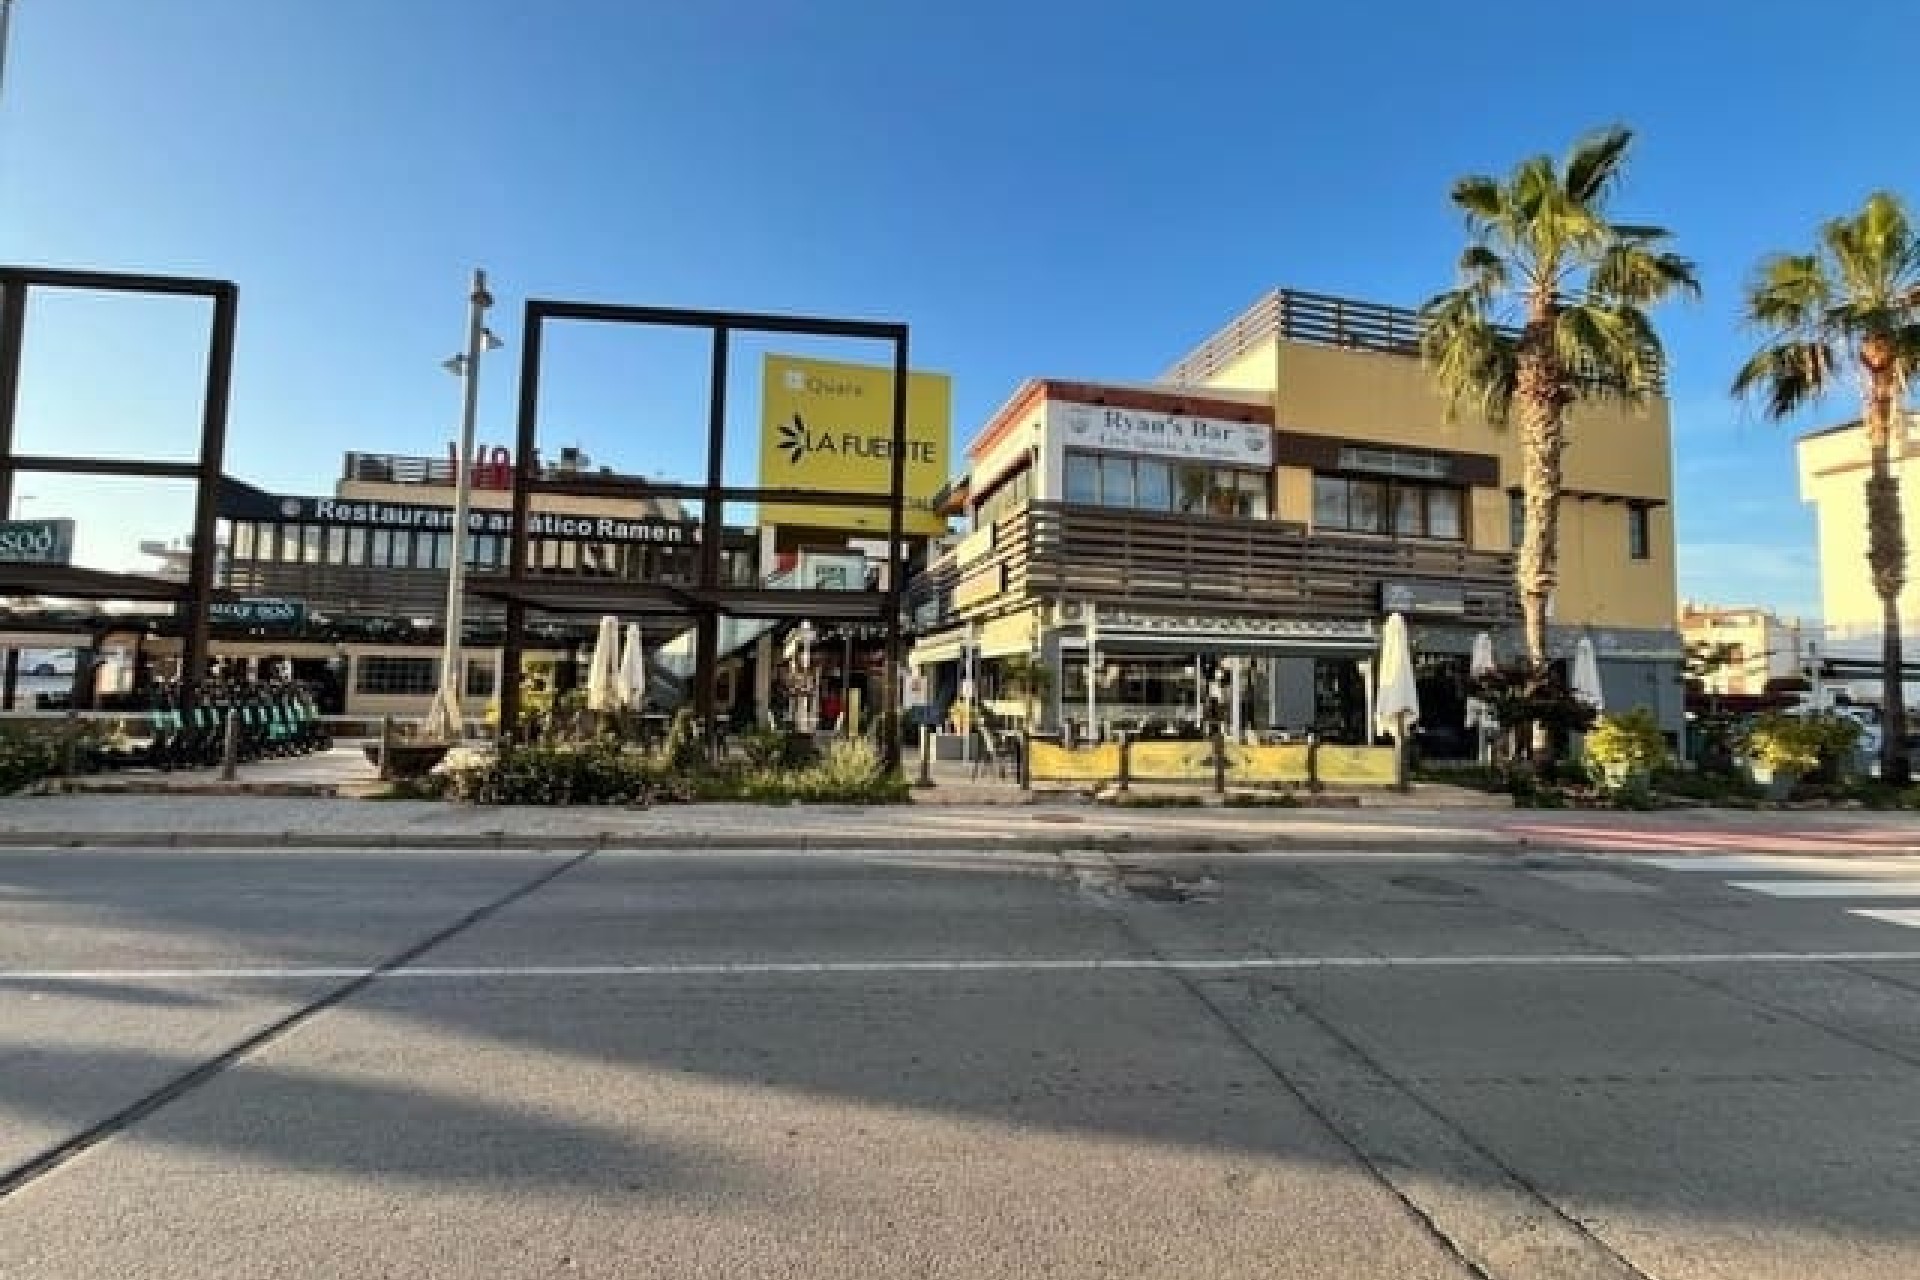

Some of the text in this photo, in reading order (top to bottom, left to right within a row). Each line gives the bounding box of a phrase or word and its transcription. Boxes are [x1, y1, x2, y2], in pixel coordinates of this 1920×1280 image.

[1104, 410, 1238, 441] Ryan's Bar
[805, 429, 937, 463] LA FUETE
[315, 499, 485, 528] Restaurane
[597, 518, 682, 543] Ramen
